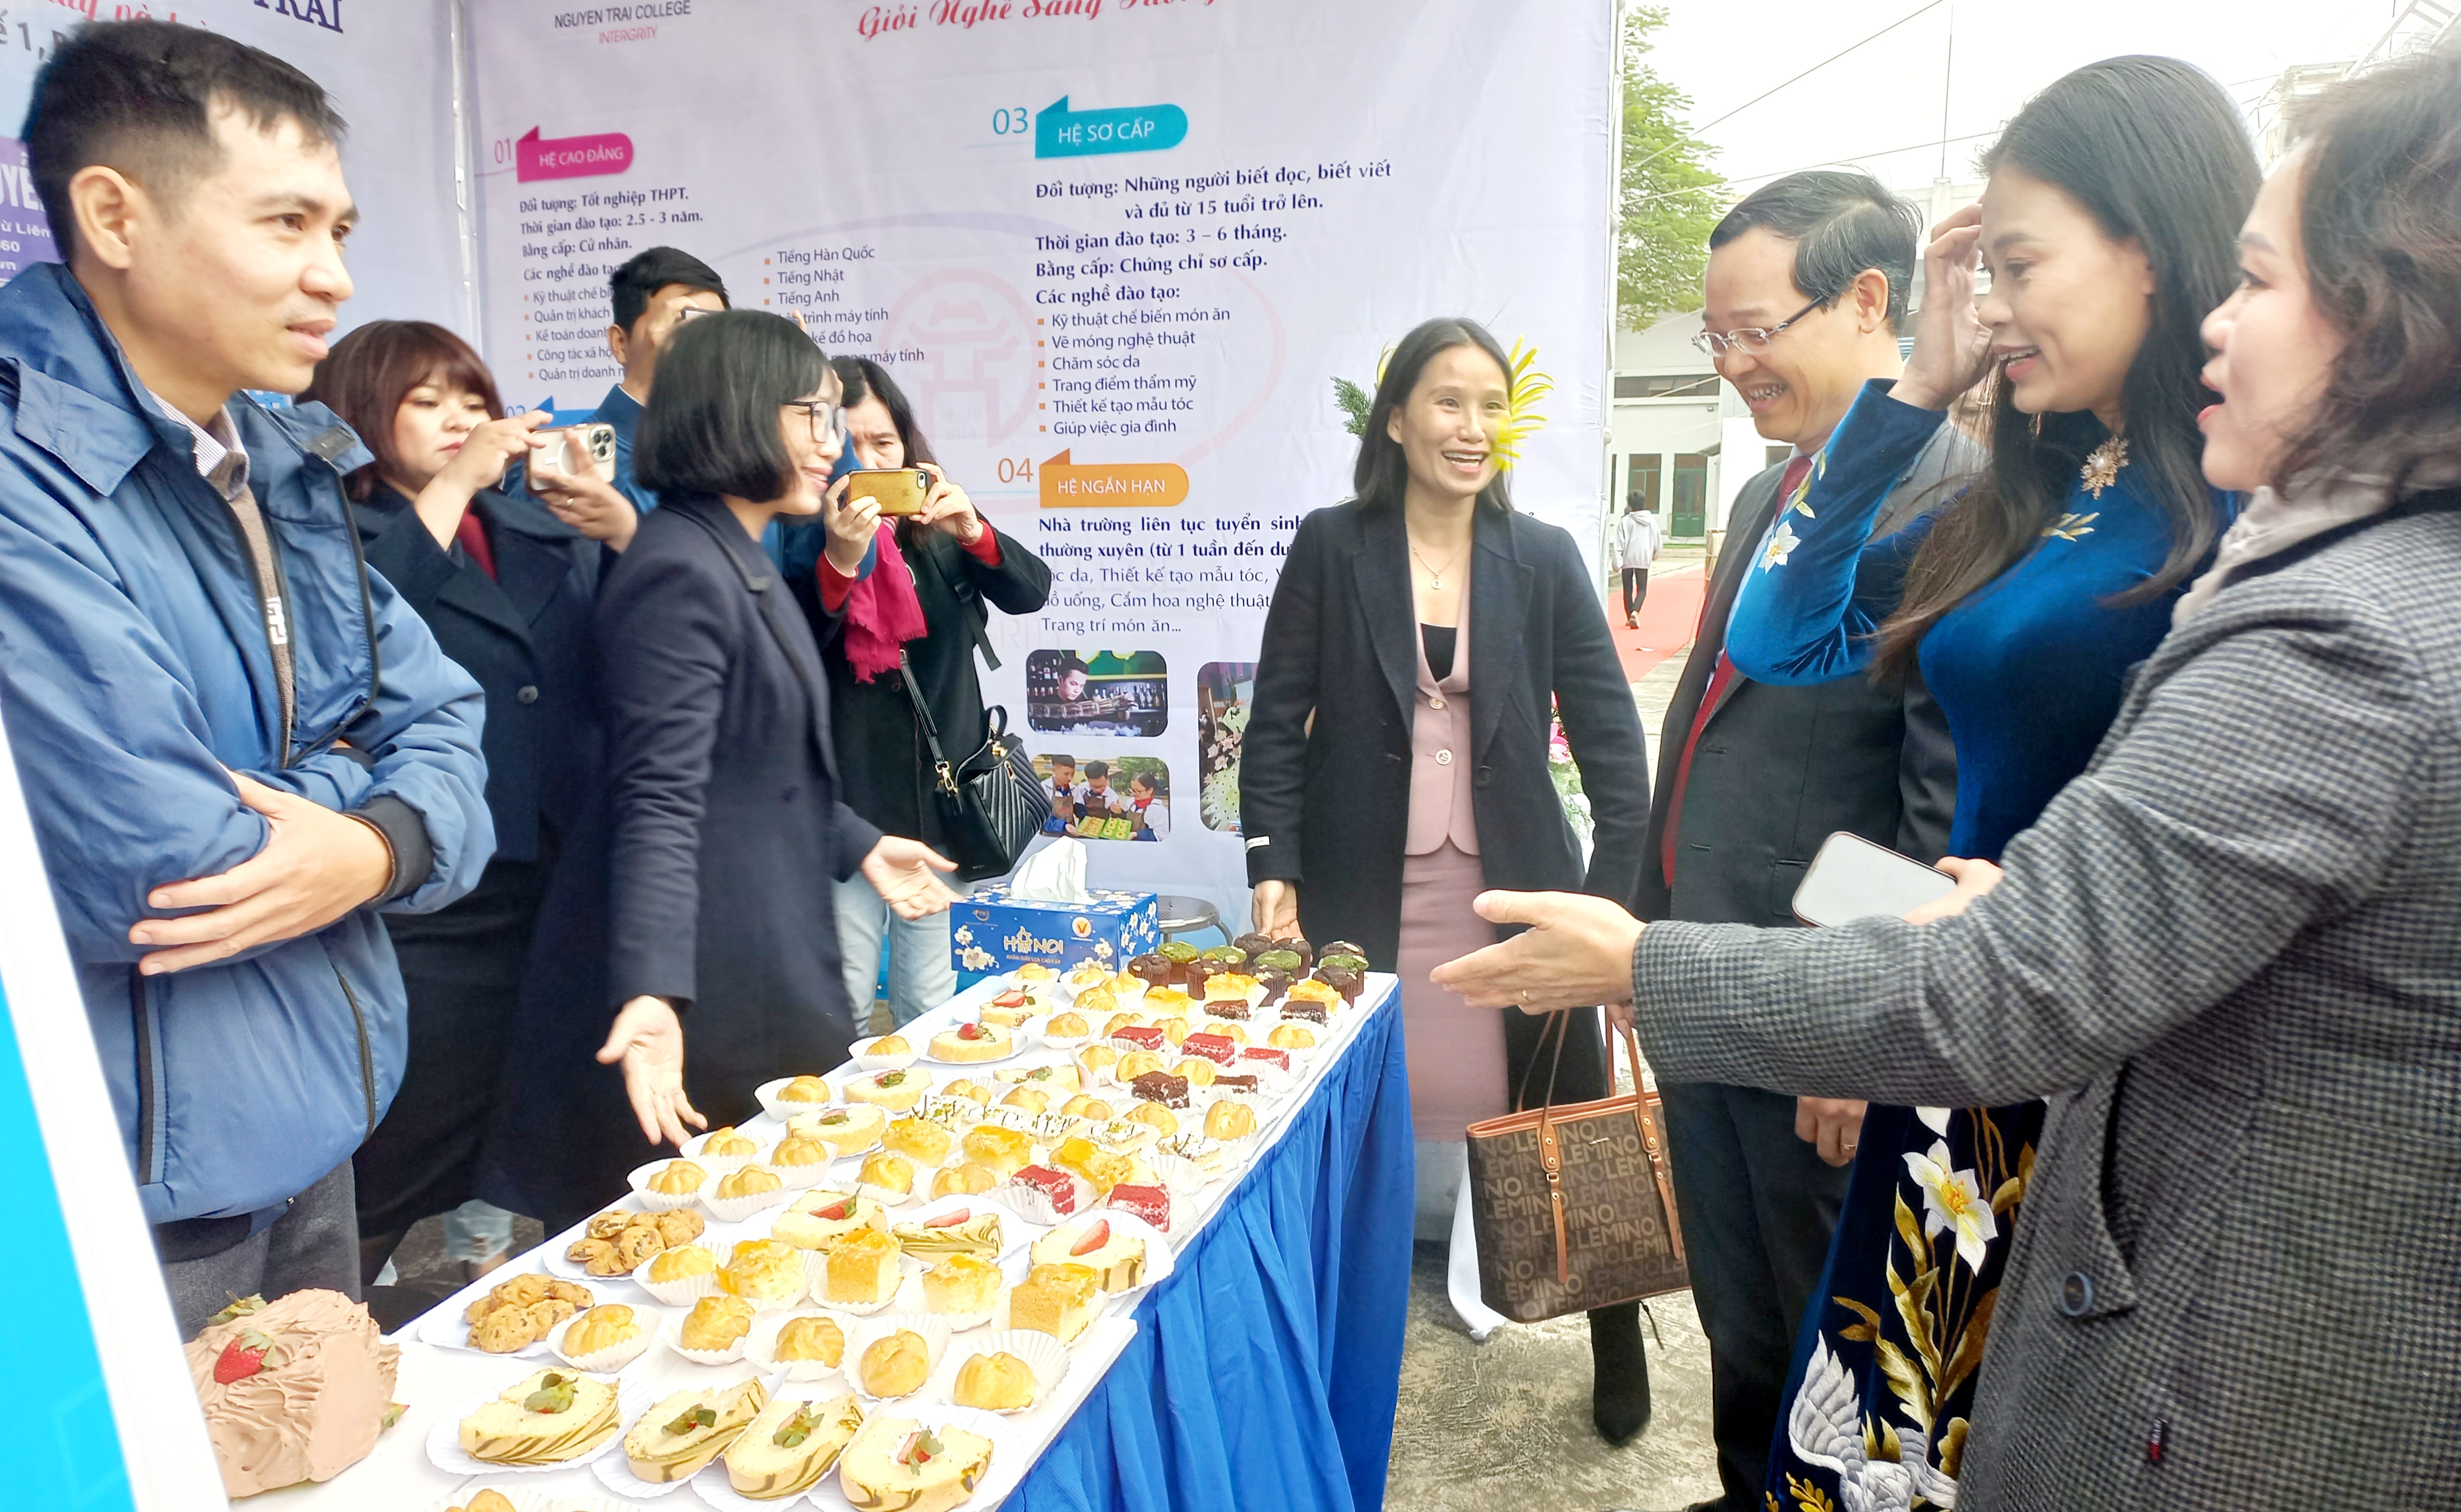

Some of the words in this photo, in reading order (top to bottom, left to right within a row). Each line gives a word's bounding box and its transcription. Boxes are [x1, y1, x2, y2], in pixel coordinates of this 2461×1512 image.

[555, 10, 602, 28] NGUYEN
[606, 7, 632, 22] TRAI
[635, 0, 690, 19] COLLEGE
[599, 26, 659, 44] INTERGRITY
[992, 108, 1029, 135] 03
[1059, 123, 1081, 146] HỆ
[1087, 122, 1113, 142] SƠ
[1118, 117, 1154, 139] CẤP
[494, 137, 512, 164] 01
[539, 151, 558, 169] HỆ
[559, 150, 584, 165] CAO
[1070, 183, 1117, 199] tượng:
[1126, 177, 1179, 194] Những
[1186, 171, 1229, 192] người
[1237, 166, 1268, 184] biết
[1276, 167, 1310, 185] đọc,
[1318, 161, 1351, 179] biết
[1359, 159, 1391, 177] viết
[1125, 204, 1142, 219] và
[1150, 202, 1168, 217] đủ
[1175, 201, 1191, 216] từ
[1198, 201, 1216, 214] 15
[1224, 194, 1254, 213] tuổi
[1262, 194, 1286, 210] trở
[1293, 194, 1323, 209] lên.
[1036, 235, 1068, 250] Thời
[1076, 234, 1108, 253] gian
[1116, 232, 1143, 246] đào
[1150, 232, 1179, 247] tạo:
[1187, 229, 1195, 242] 3
[1218, 227, 1227, 240] 6
[1234, 224, 1286, 242] tháng.
[778, 250, 810, 265] Tiếng
[814, 249, 838, 261] Hàn
[843, 245, 874, 261] Quốc
[1037, 260, 1075, 279] Bằng
[1081, 257, 1113, 278] cấp:
[1120, 258, 1172, 275] Chứng
[1179, 254, 1203, 269] chỉ
[1210, 256, 1227, 268] sơ
[1233, 250, 1267, 270] cấp.
[778, 270, 811, 286] Tiếng
[814, 269, 844, 283] Nhật
[778, 291, 811, 307] Tiếng
[815, 290, 839, 302] Anh
[1036, 290, 1065, 303] Các
[1072, 284, 1110, 306] nghề
[1116, 286, 1144, 300] đào
[1151, 286, 1179, 302] tạo:
[835, 310, 862, 325] máy
[865, 308, 888, 321] tính
[1053, 314, 1068, 330] Kỹ
[1072, 312, 1108, 328] thuật
[1112, 309, 1137, 324] chế
[1141, 308, 1171, 323] biến
[1176, 308, 1208, 321] món
[1213, 308, 1229, 320] ăn
[849, 330, 871, 345] họa
[1052, 336, 1069, 348] Vẽ
[1073, 335, 1113, 350] móng
[1118, 332, 1153, 349] nghệ
[1158, 331, 1195, 346] thuật
[870, 349, 896, 364] máy
[899, 349, 924, 361] tính
[1053, 357, 1092, 370] Chăm
[1097, 356, 1119, 368] sóc
[1123, 354, 1139, 367] da
[1053, 379, 1091, 394] Trang
[1095, 375, 1129, 390] điểm
[1134, 374, 1170, 389] thẩm
[1175, 375, 1196, 391] mỹ
[1053, 399, 1087, 412] Thiết
[1092, 398, 1106, 412] kế
[1111, 401, 1132, 414] tạo
[1137, 396, 1167, 410] mẫu
[1172, 397, 1193, 410] tóc
[1054, 422, 1086, 436] Giúp
[1090, 420, 1117, 435] việc
[1121, 420, 1141, 436] gia
[1145, 419, 1176, 432] đình
[998, 457, 1034, 483] 04
[1058, 478, 1077, 497] HỆ
[1082, 476, 1126, 493] NGẮN
[1132, 480, 1165, 495] HẠN
[1040, 518, 1070, 531] Nhà
[1081, 518, 1131, 535] trường
[1142, 517, 1170, 531] liên
[1181, 519, 1205, 534] tục
[1216, 513, 1260, 534] tuyển
[1039, 543, 1093, 562] thường
[1099, 543, 1143, 560] xuyên
[1151, 543, 1172, 558] (từ
[1180, 544, 1183, 556] 1
[1193, 540, 1227, 556] tuần
[1234, 540, 1263, 556] đến
[1070, 567, 1093, 583] da,
[1100, 566, 1139, 582] Thiết
[1146, 566, 1165, 581] kế
[1170, 571, 1193, 583] tạo
[1200, 566, 1233, 581] mẫu
[1240, 568, 1268, 583] tóc,
[1064, 591, 1104, 611] uống,
[1111, 591, 1146, 607] Cắm
[1153, 593, 1179, 607] hoa
[1186, 593, 1224, 611] nghệ
[1230, 592, 1271, 610] thuật
[1042, 618, 1085, 635] Trang
[1091, 618, 1105, 631] trí
[1112, 619, 1144, 631] món
